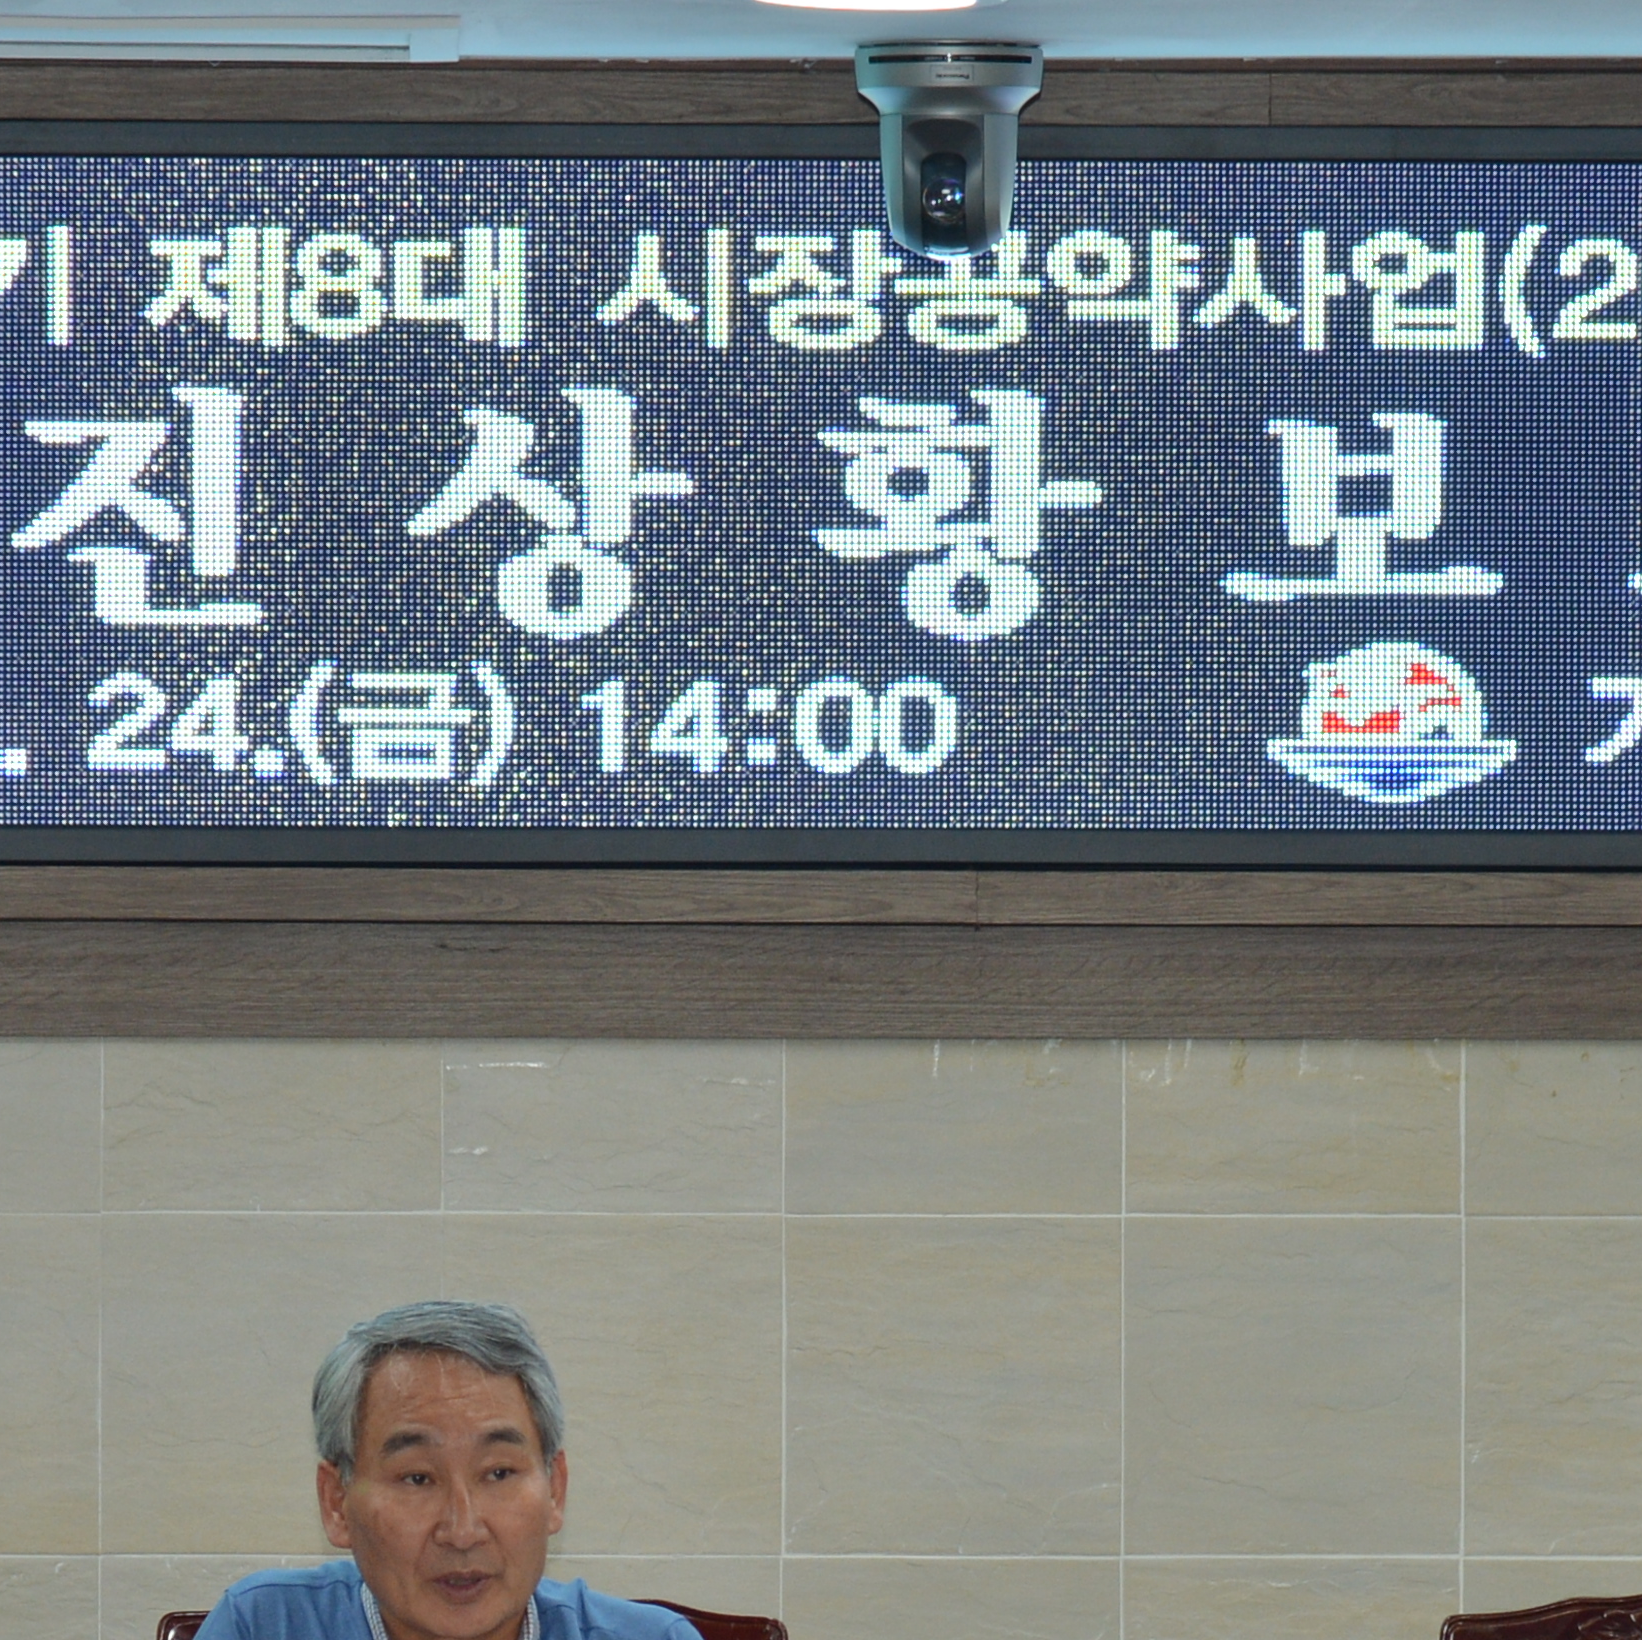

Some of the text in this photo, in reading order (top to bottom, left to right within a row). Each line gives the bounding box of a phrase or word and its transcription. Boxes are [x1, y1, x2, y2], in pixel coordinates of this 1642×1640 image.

[144, 224, 528, 349] 제8대
[85, 661, 517, 793] 24.(금)
[582, 675, 959, 777] 14:00
